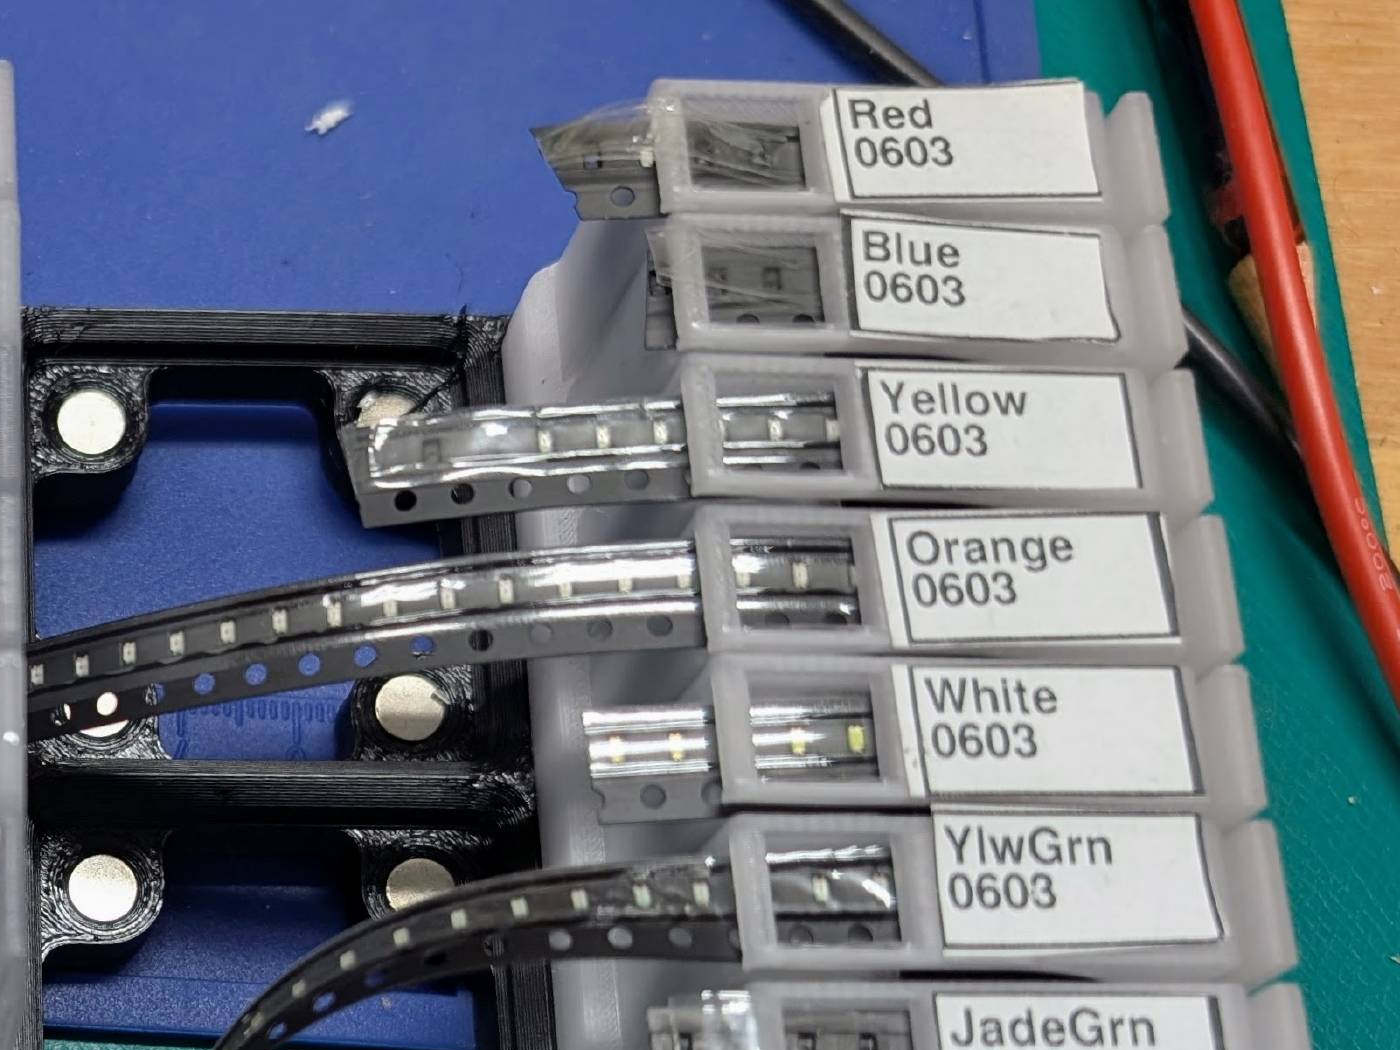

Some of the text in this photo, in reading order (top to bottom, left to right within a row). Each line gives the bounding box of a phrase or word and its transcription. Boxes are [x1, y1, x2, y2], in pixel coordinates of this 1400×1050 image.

[848, 99, 933, 129] Red
[855, 136, 954, 167] 0603
[863, 230, 960, 268] Blue
[864, 270, 966, 307] 0603
[880, 381, 1027, 416] Yellow
[885, 422, 988, 457] 0603
[907, 530, 1073, 574] Orange
[913, 572, 1017, 607] 0603
[925, 678, 1057, 714] White
[932, 722, 1038, 758] 0603
[945, 826, 1112, 865] YlwGrn
[949, 873, 1057, 910] 0603
[951, 1007, 1156, 1047] JadeGrn
